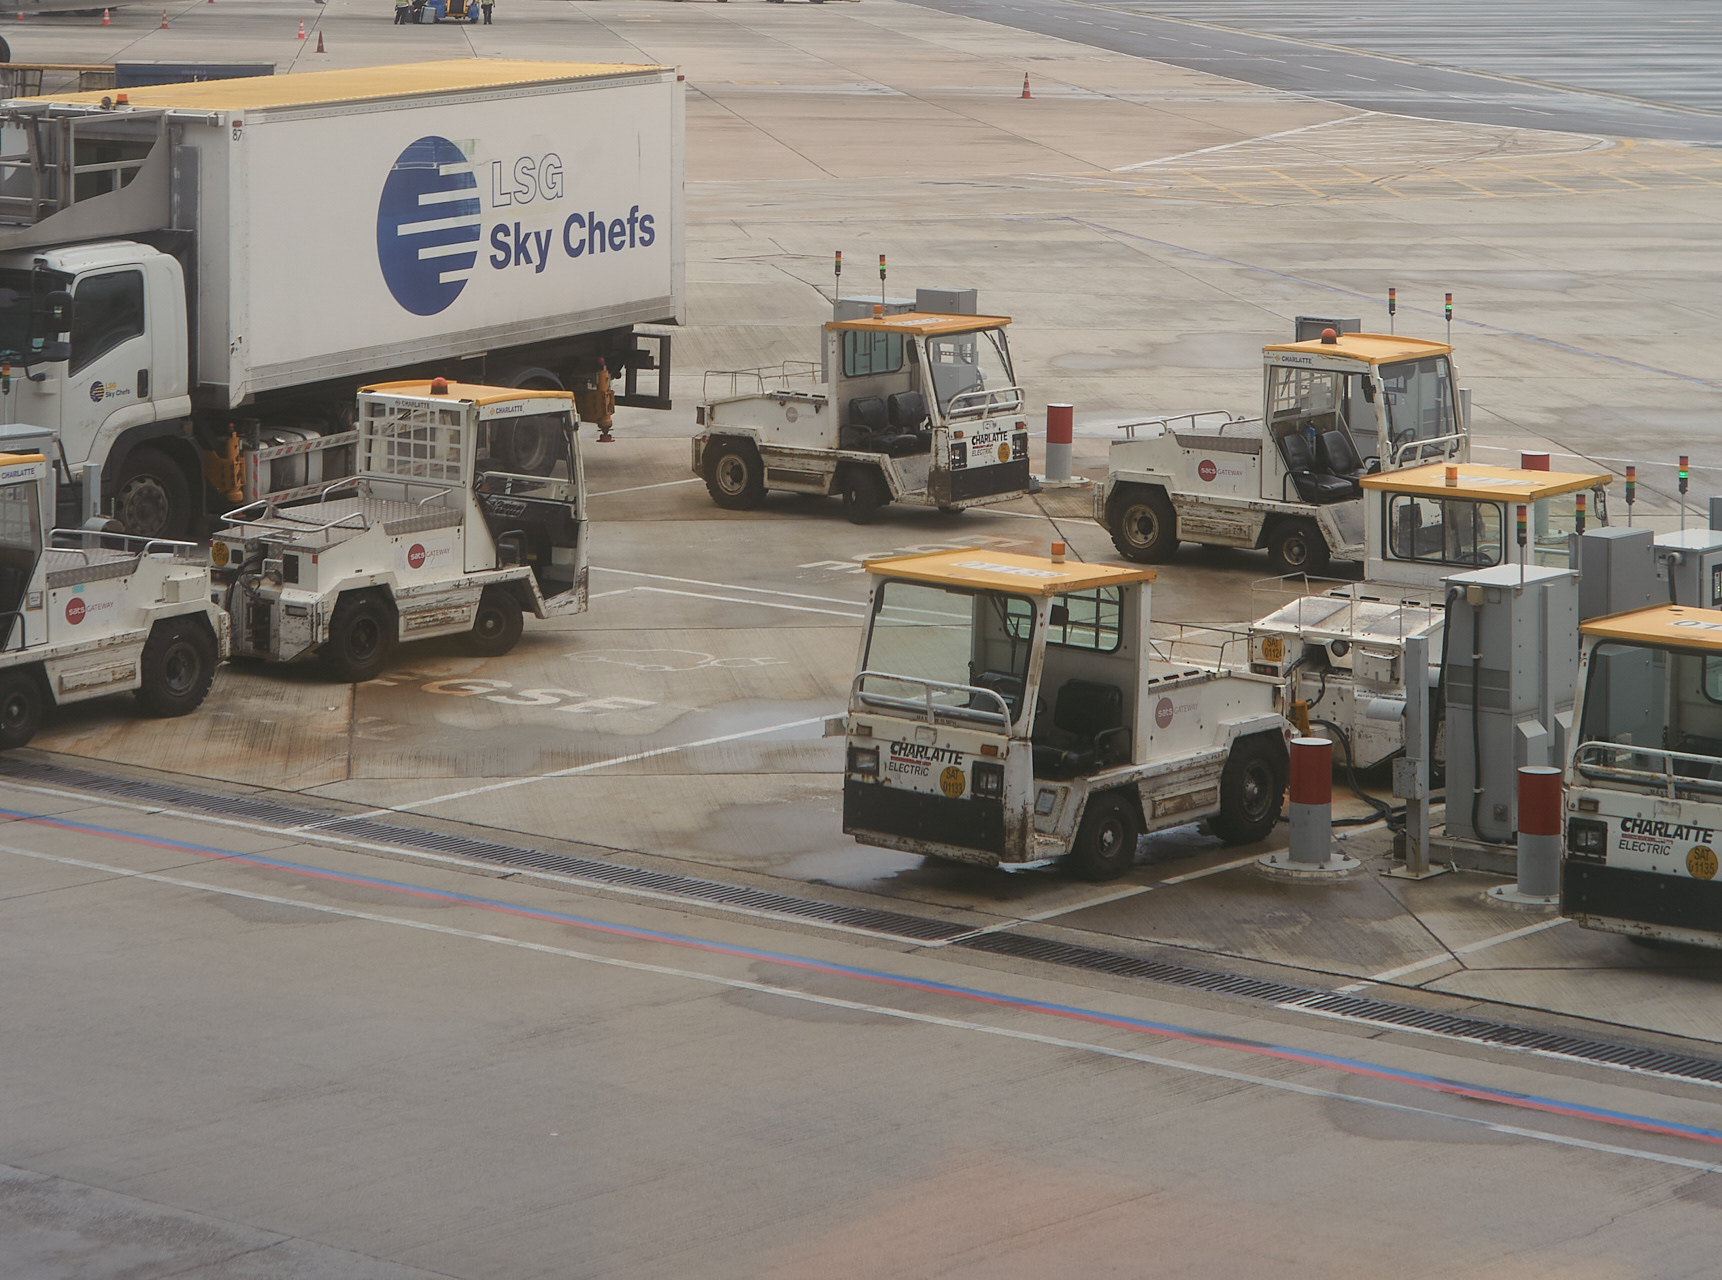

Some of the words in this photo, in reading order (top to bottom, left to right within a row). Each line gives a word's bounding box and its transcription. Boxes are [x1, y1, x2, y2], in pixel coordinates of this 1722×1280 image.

[232, 128, 242, 142] 87
[491, 152, 564, 208] LSG
[489, 222, 553, 274] Sky
[562, 205, 656, 258] Chefs
[1281, 355, 1312, 365] CHARLATTE
[105, 391, 115, 399] Sky
[116, 388, 131, 396] Chefs
[401, 400, 430, 409] CHARLATTE
[495, 405, 523, 415] CHARLATTE
[971, 431, 1008, 446] CHARLATTE
[971, 447, 993, 457] ELECTRIC
[1, 467, 36, 479] CHARLATTE
[410, 551, 425, 561] sats
[425, 548, 451, 558] GATEWAY
[68, 606, 86, 616] sats
[86, 601, 114, 612] GATEWAY
[420, 678, 658, 713] GSE
[1158, 707, 1173, 718] sats
[1174, 703, 1199, 714] GATEWAY
[890, 741, 964, 766] CHARLATTE
[888, 761, 930, 777] ELECTRIC
[945, 768, 959, 780] SAT
[1620, 817, 1715, 844] CHARLATTE
[1618, 839, 1672, 856] ELECTRIC
[1693, 847, 1710, 861] SAT
